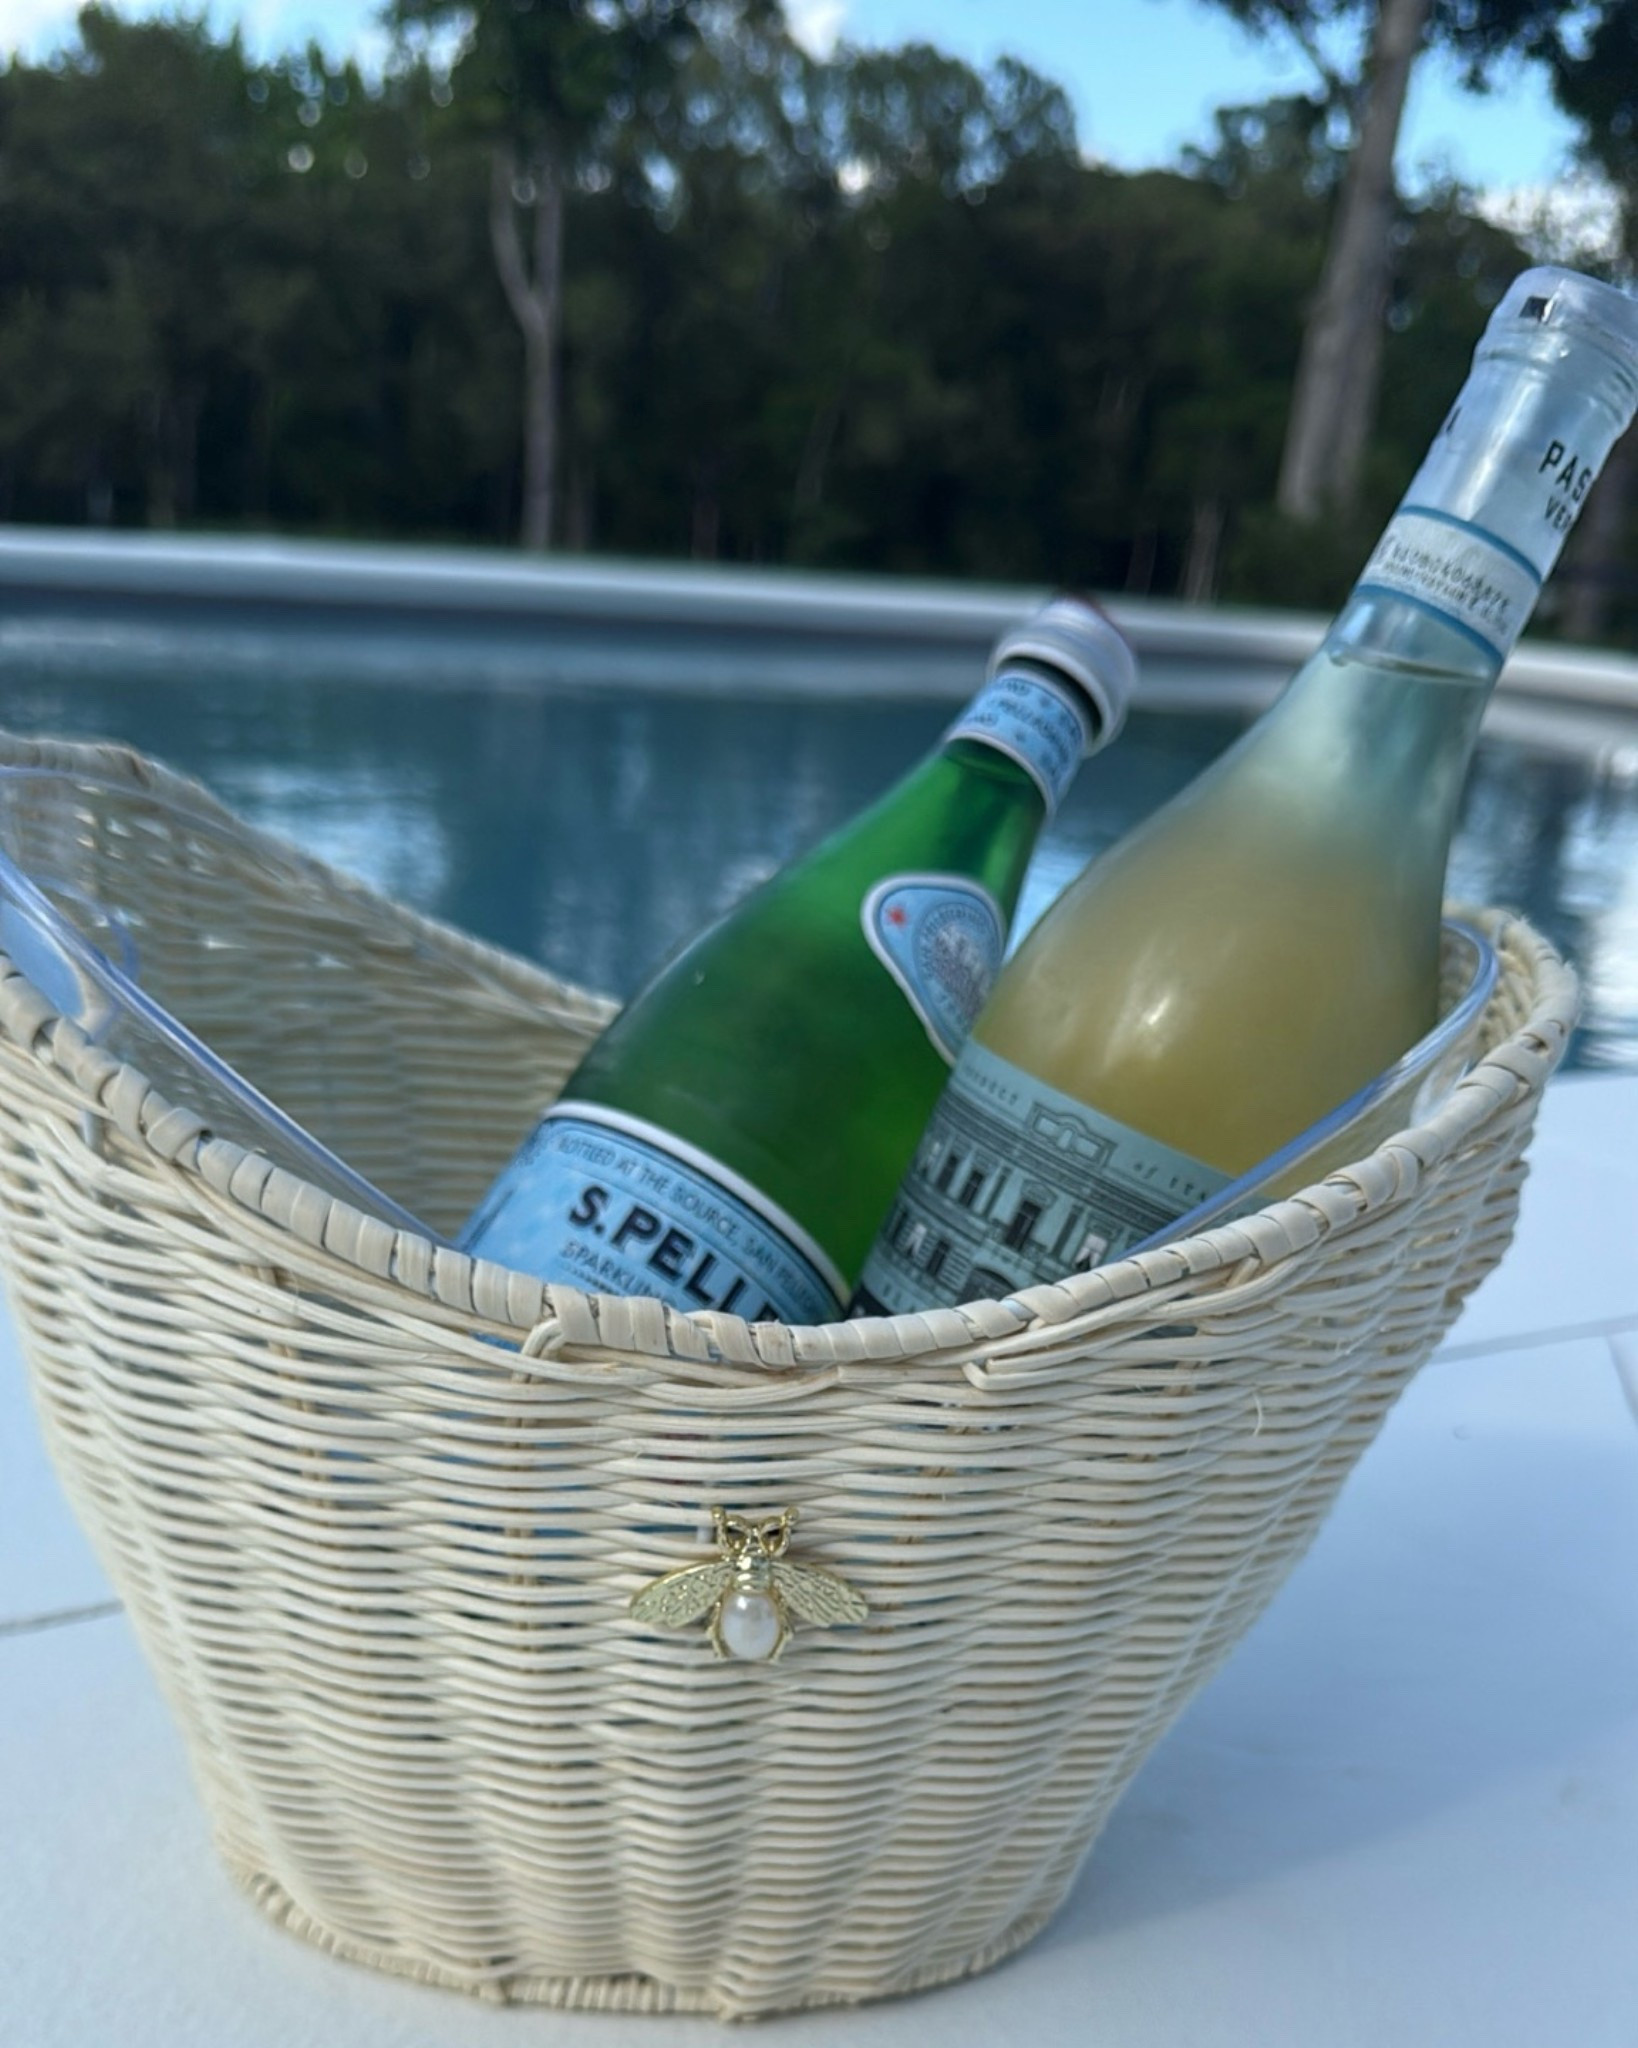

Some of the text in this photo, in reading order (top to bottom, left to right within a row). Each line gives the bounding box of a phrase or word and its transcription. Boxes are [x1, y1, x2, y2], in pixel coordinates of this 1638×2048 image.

[1538, 440, 1592, 504] PAS
[559, 1136, 616, 1167] BOTTLED
[616, 1157, 640, 1178] AT
[640, 1165, 670, 1195] THE
[670, 1181, 740, 1246] SOURCE,
[560, 1237, 677, 1305] SPARKLIN
